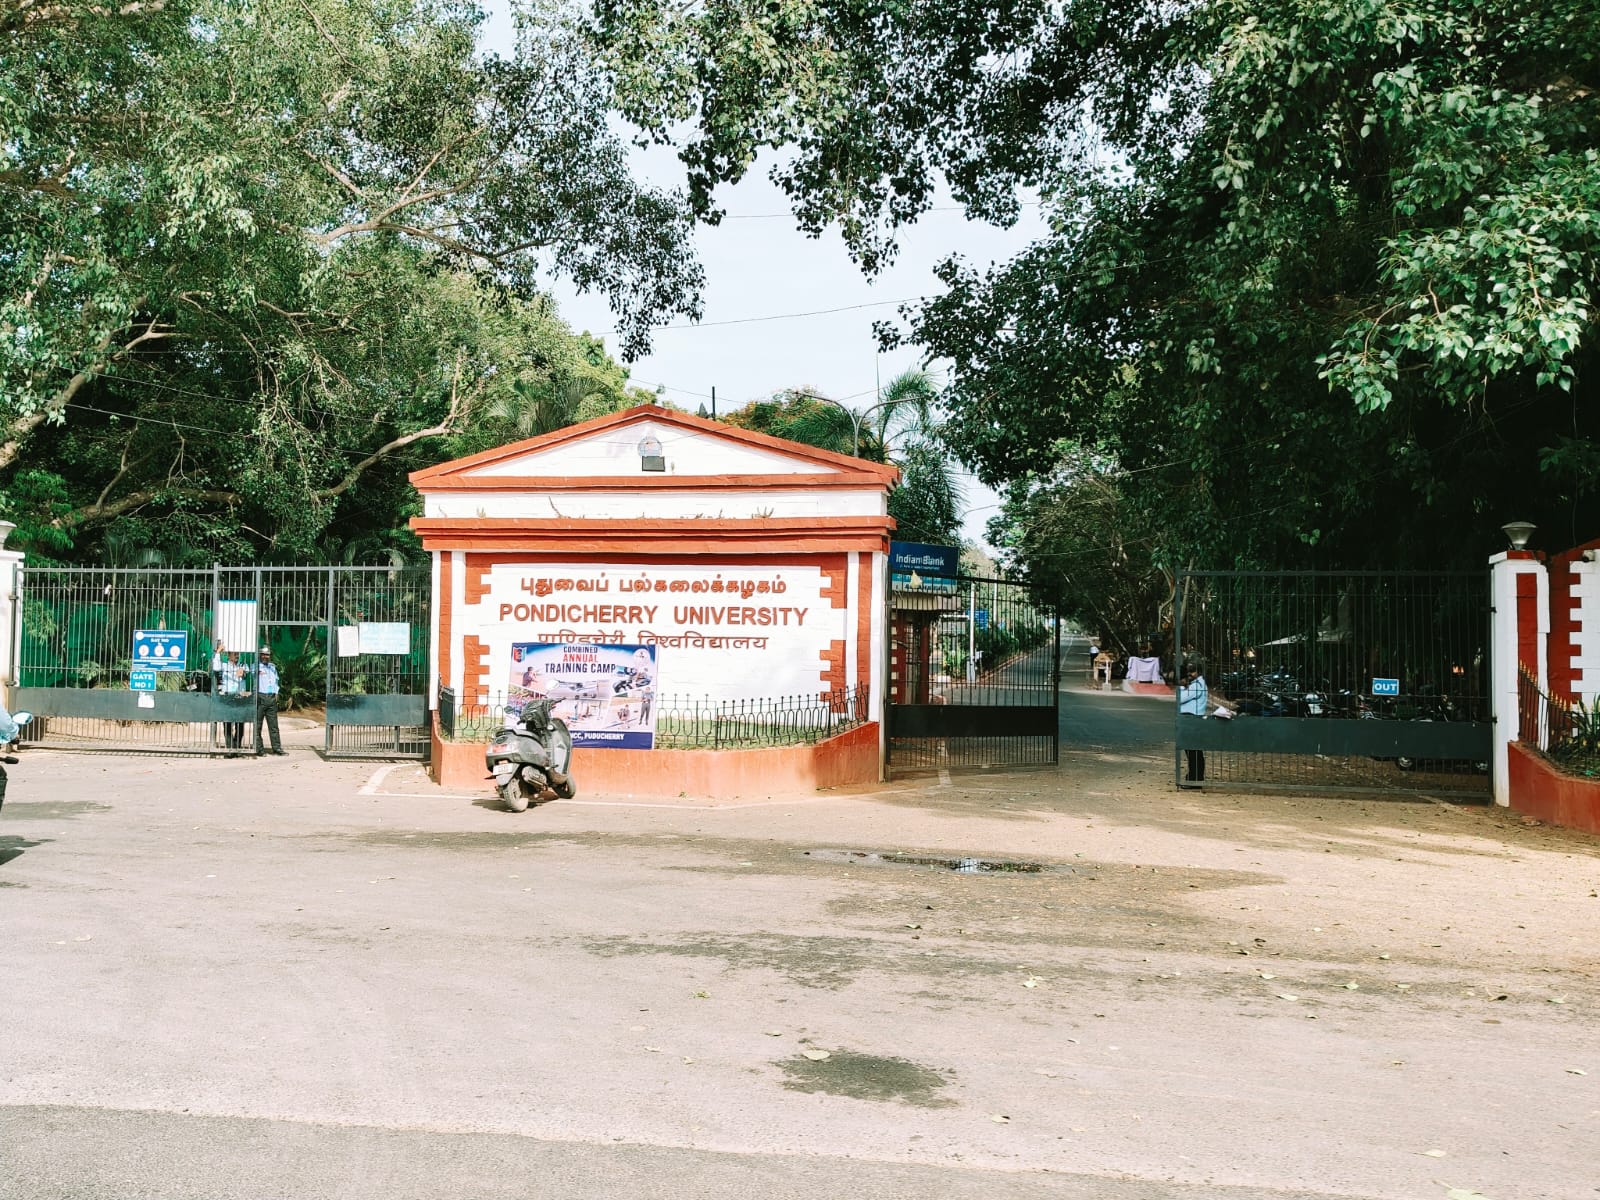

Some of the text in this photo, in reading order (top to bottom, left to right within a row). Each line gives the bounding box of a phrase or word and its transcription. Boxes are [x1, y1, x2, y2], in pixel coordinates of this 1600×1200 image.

[895, 553, 945, 566] Indian Bank
[521, 572, 787, 599] புதுவைப் பல்கலைக்கழகம்
[499, 603, 809, 626] PONDICHERRY UNIVERSITY
[562, 654, 599, 663] ANNUAL
[545, 663, 616, 673] TRAINING CAMP
[1374, 683, 1397, 691] OUT
[584, 733, 625, 741] PUDUCHERRY
